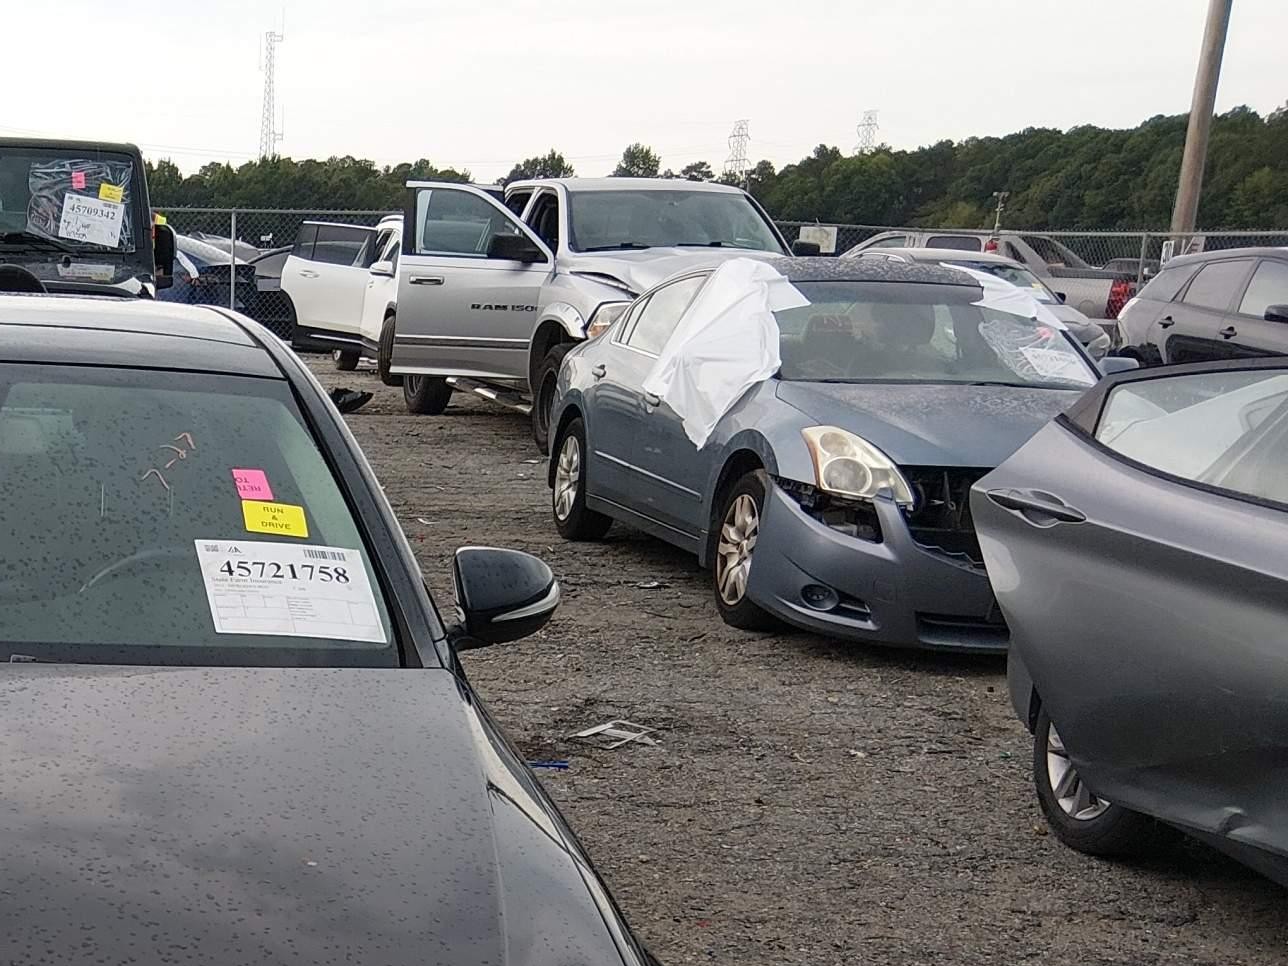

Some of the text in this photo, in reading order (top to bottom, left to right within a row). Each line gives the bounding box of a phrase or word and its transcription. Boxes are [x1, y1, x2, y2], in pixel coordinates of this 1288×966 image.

[69, 203, 116, 220] 45709342
[470, 303, 508, 311] RAM
[262, 505, 285, 514] RUN
[260, 520, 292, 530] DRIVE
[219, 559, 350, 584] 45721758
